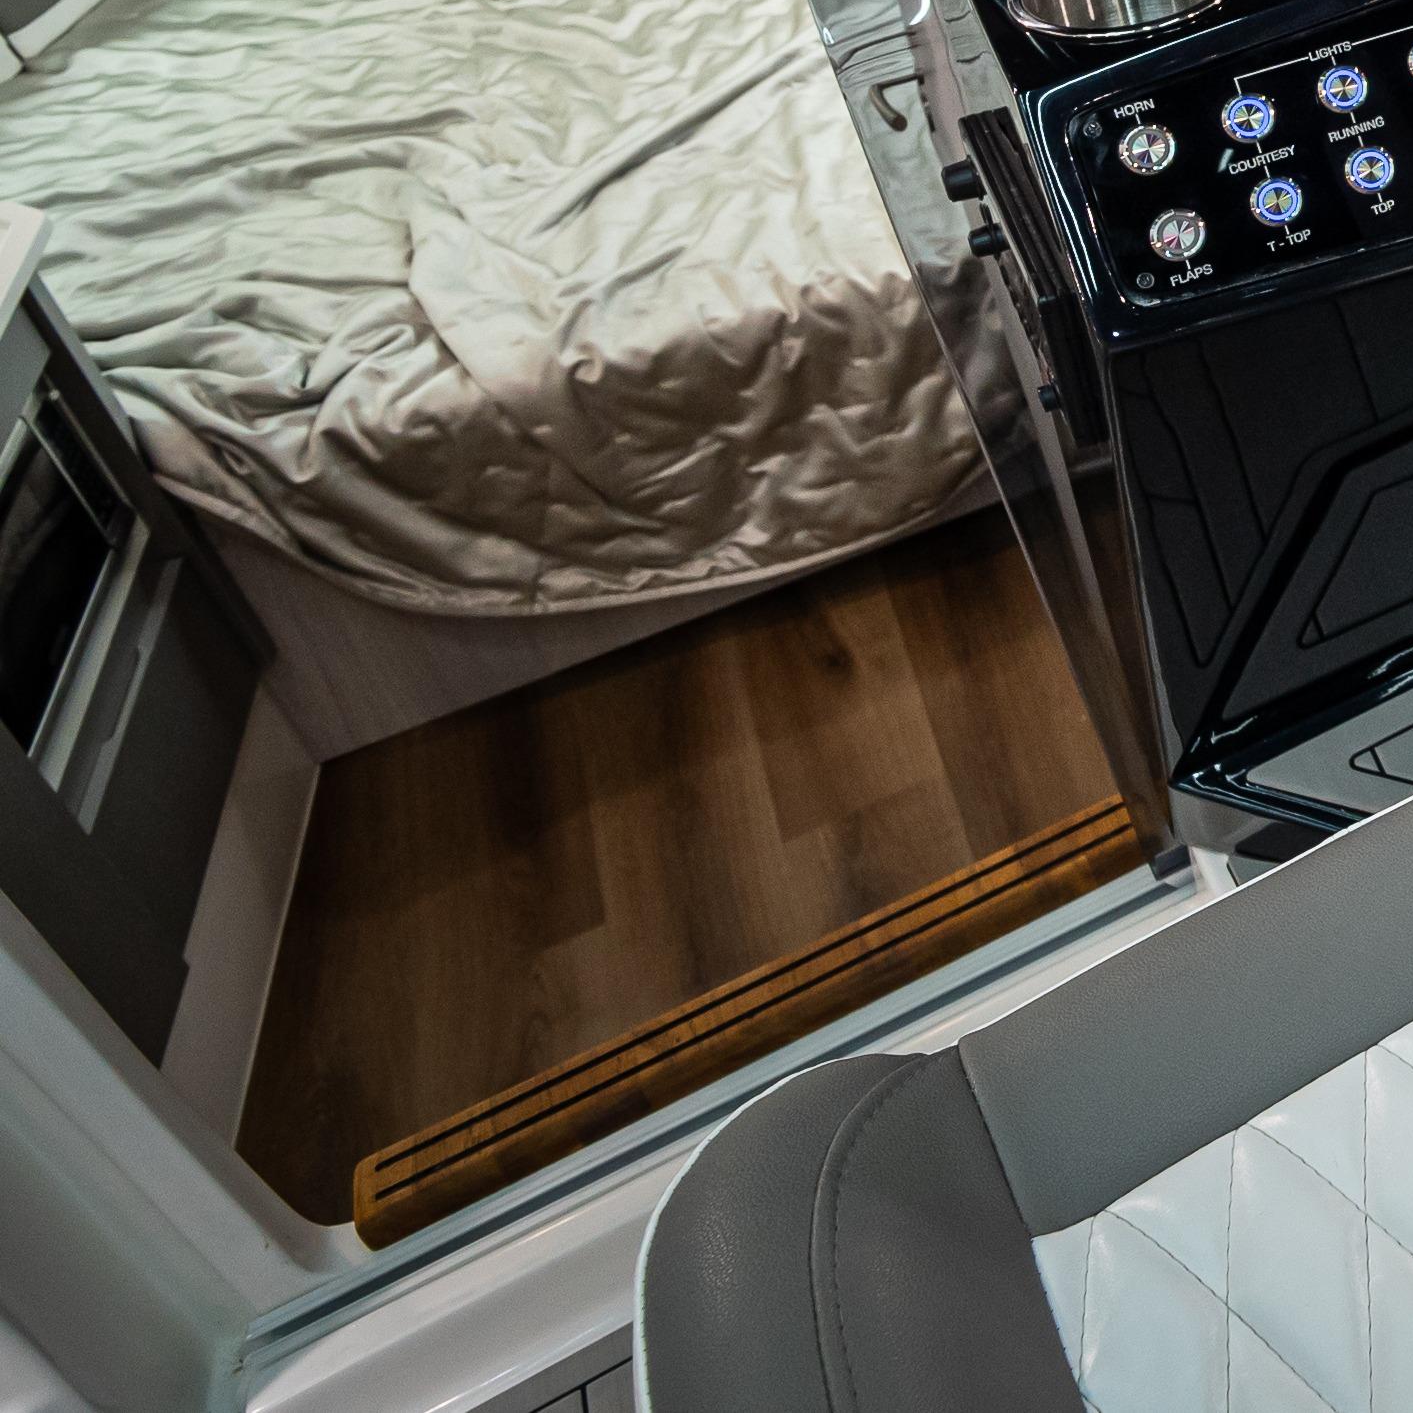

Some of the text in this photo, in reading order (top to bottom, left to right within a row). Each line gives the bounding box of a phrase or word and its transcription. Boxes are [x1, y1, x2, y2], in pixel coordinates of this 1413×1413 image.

[1308, 41, 1352, 63] LIGHTS
[1113, 98, 1156, 119] HORN
[1327, 115, 1386, 143] RUNNING
[1228, 144, 1296, 176] COURTESY
[1370, 199, 1396, 216] TOP
[1169, 264, 1214, 287] FLAPS
